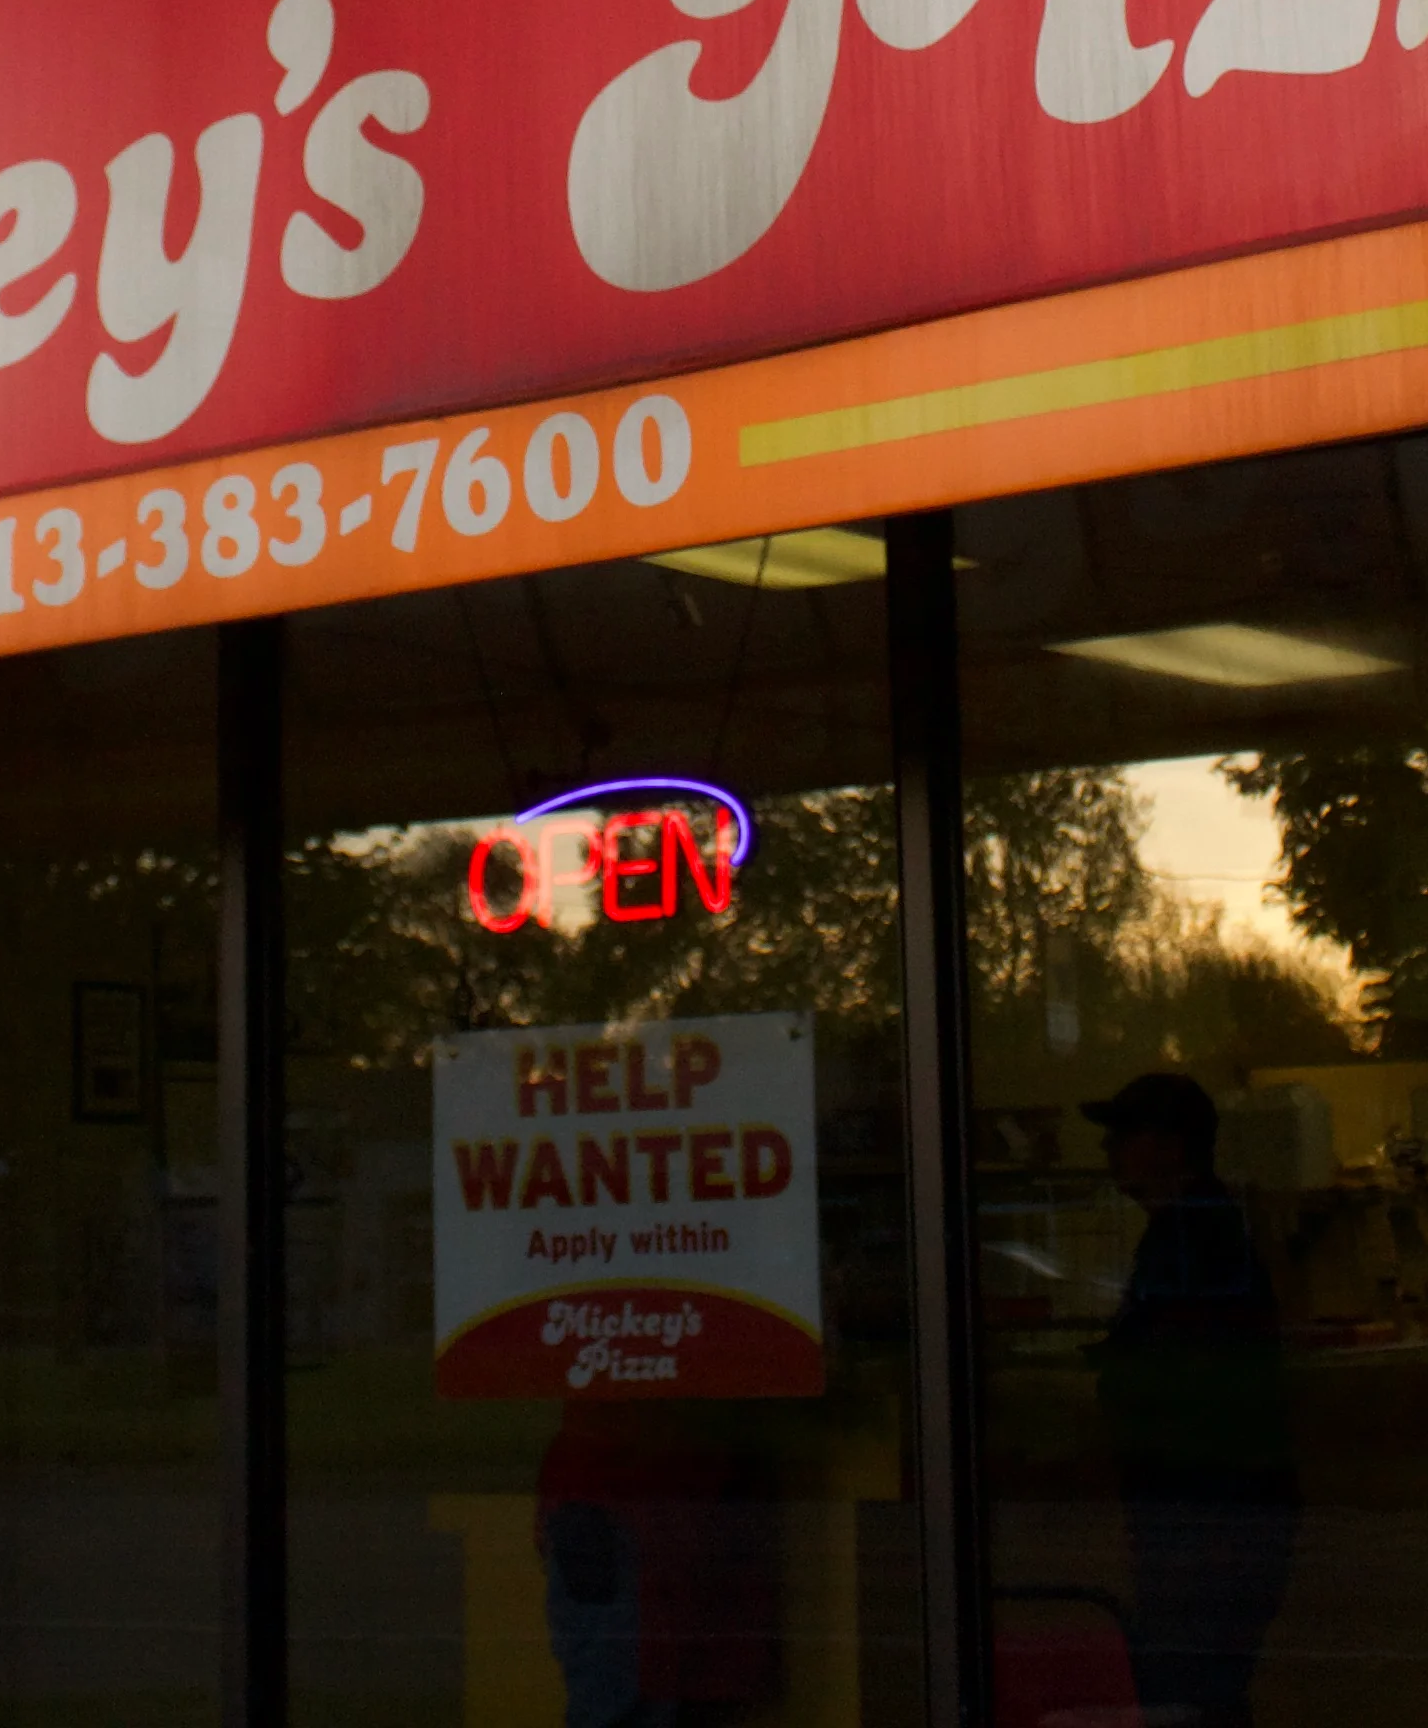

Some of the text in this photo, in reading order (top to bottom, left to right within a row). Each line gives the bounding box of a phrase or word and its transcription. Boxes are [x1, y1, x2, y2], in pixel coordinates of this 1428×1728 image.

[468, 805, 732, 933] OPEN
[514, 1033, 723, 1119] HELP
[452, 1123, 794, 1212] WANTED
[527, 1221, 731, 1265] Apply within
[540, 1299, 704, 1347] Mickey's
[566, 1338, 680, 1390] Pizza
